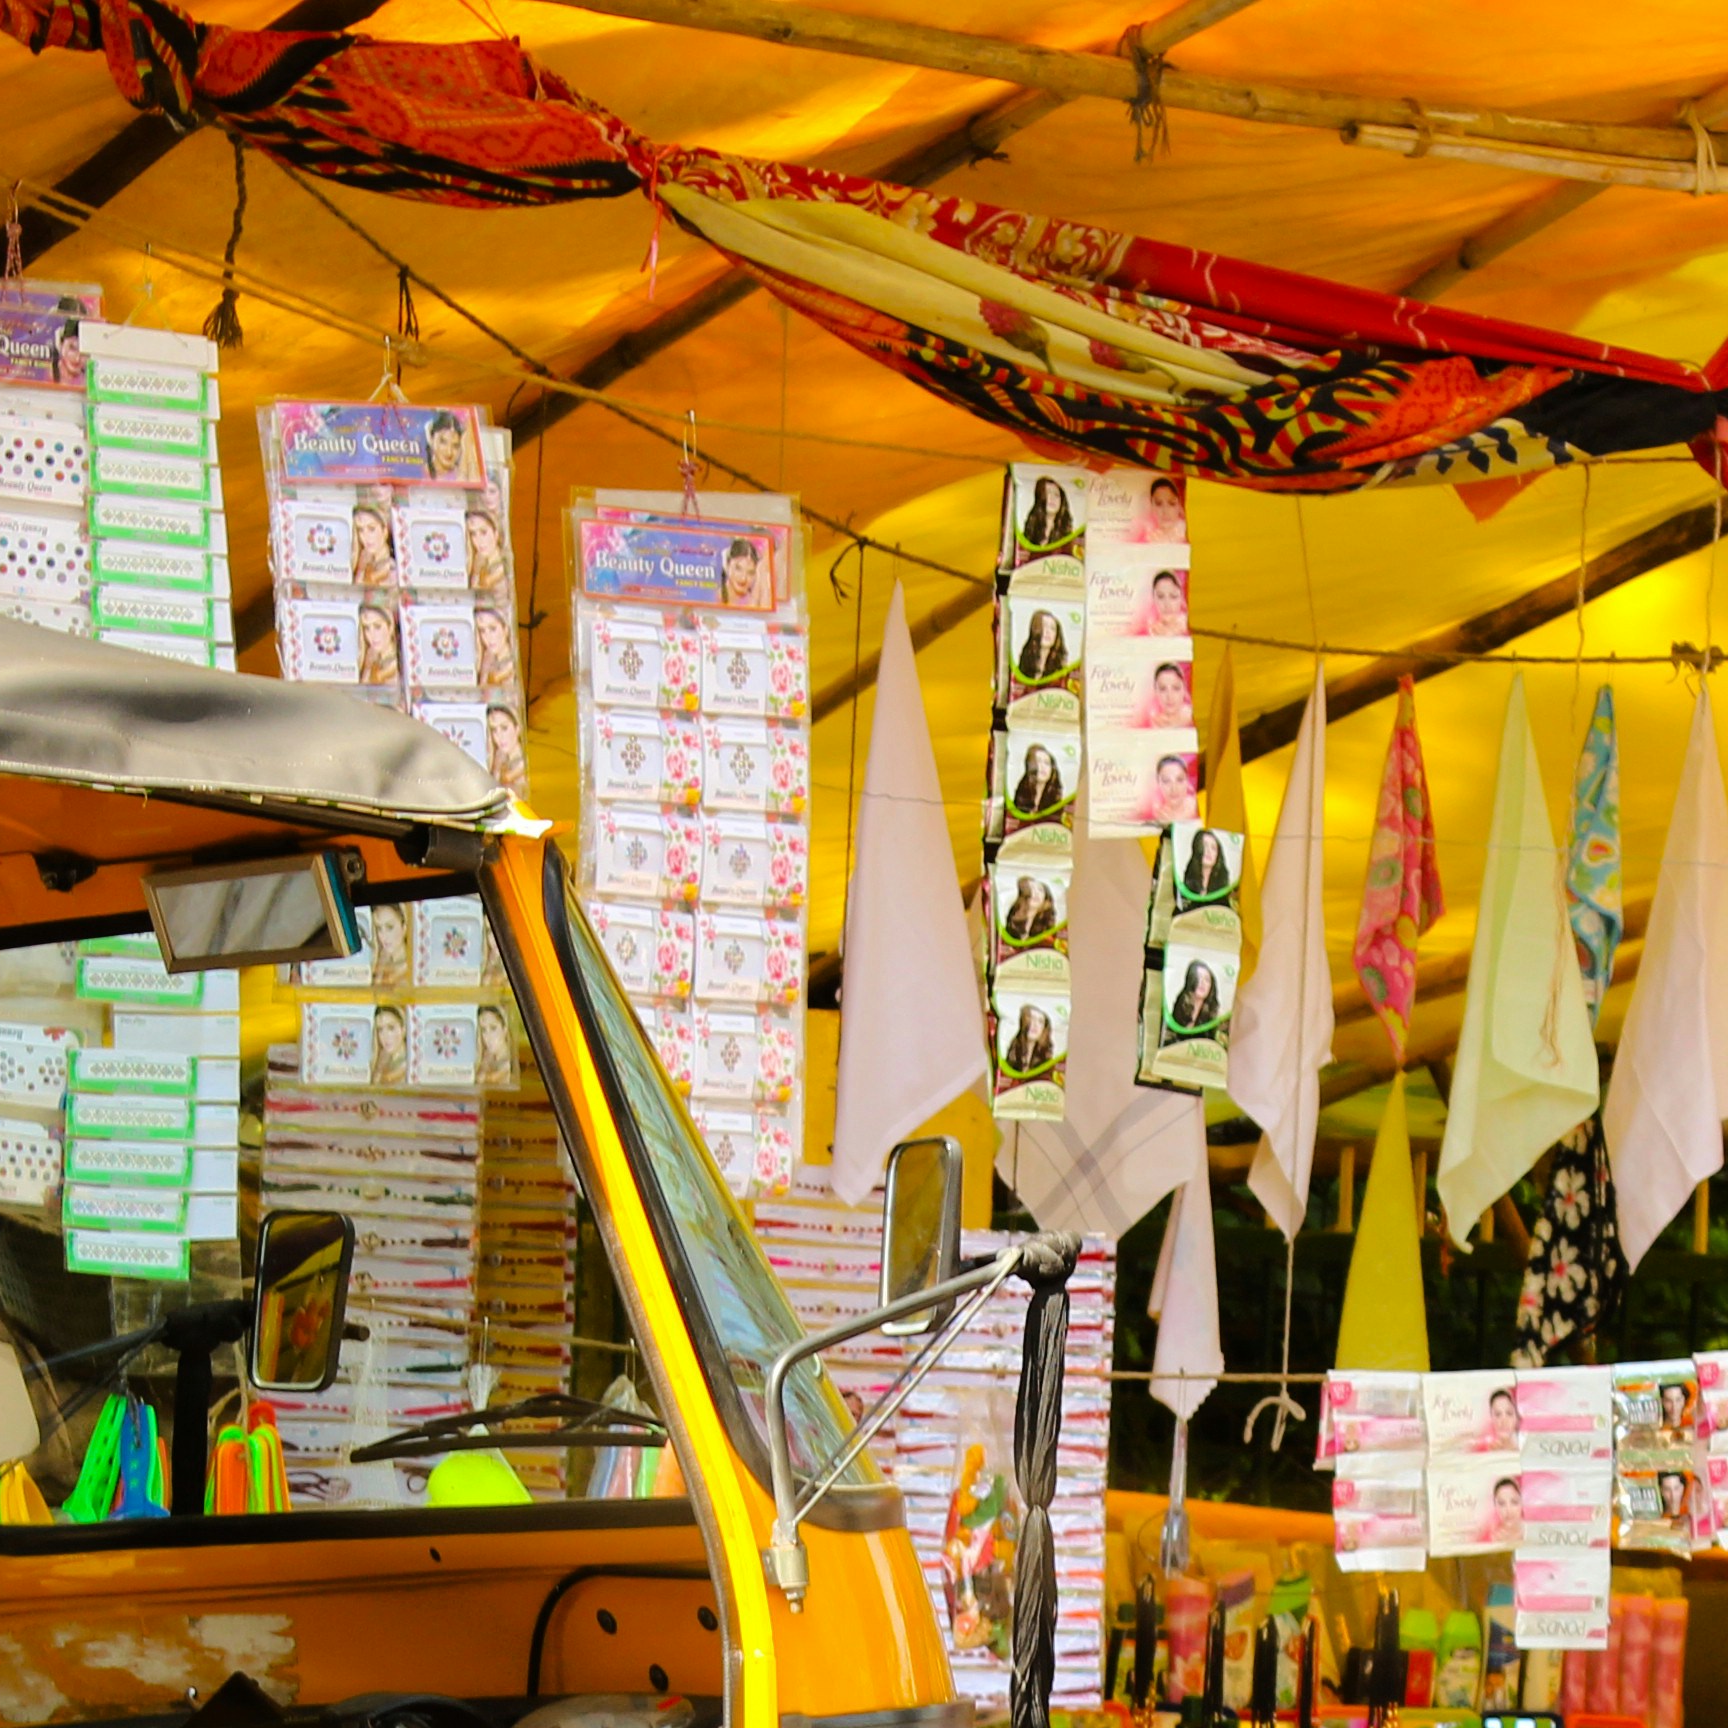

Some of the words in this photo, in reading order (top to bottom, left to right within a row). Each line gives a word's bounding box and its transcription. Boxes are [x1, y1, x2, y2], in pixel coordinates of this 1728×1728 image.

[294, 433, 357, 456] Beauty
[363, 433, 421, 455] Queen
[595, 550, 655, 577] Beauty
[659, 557, 716, 580] Queen
